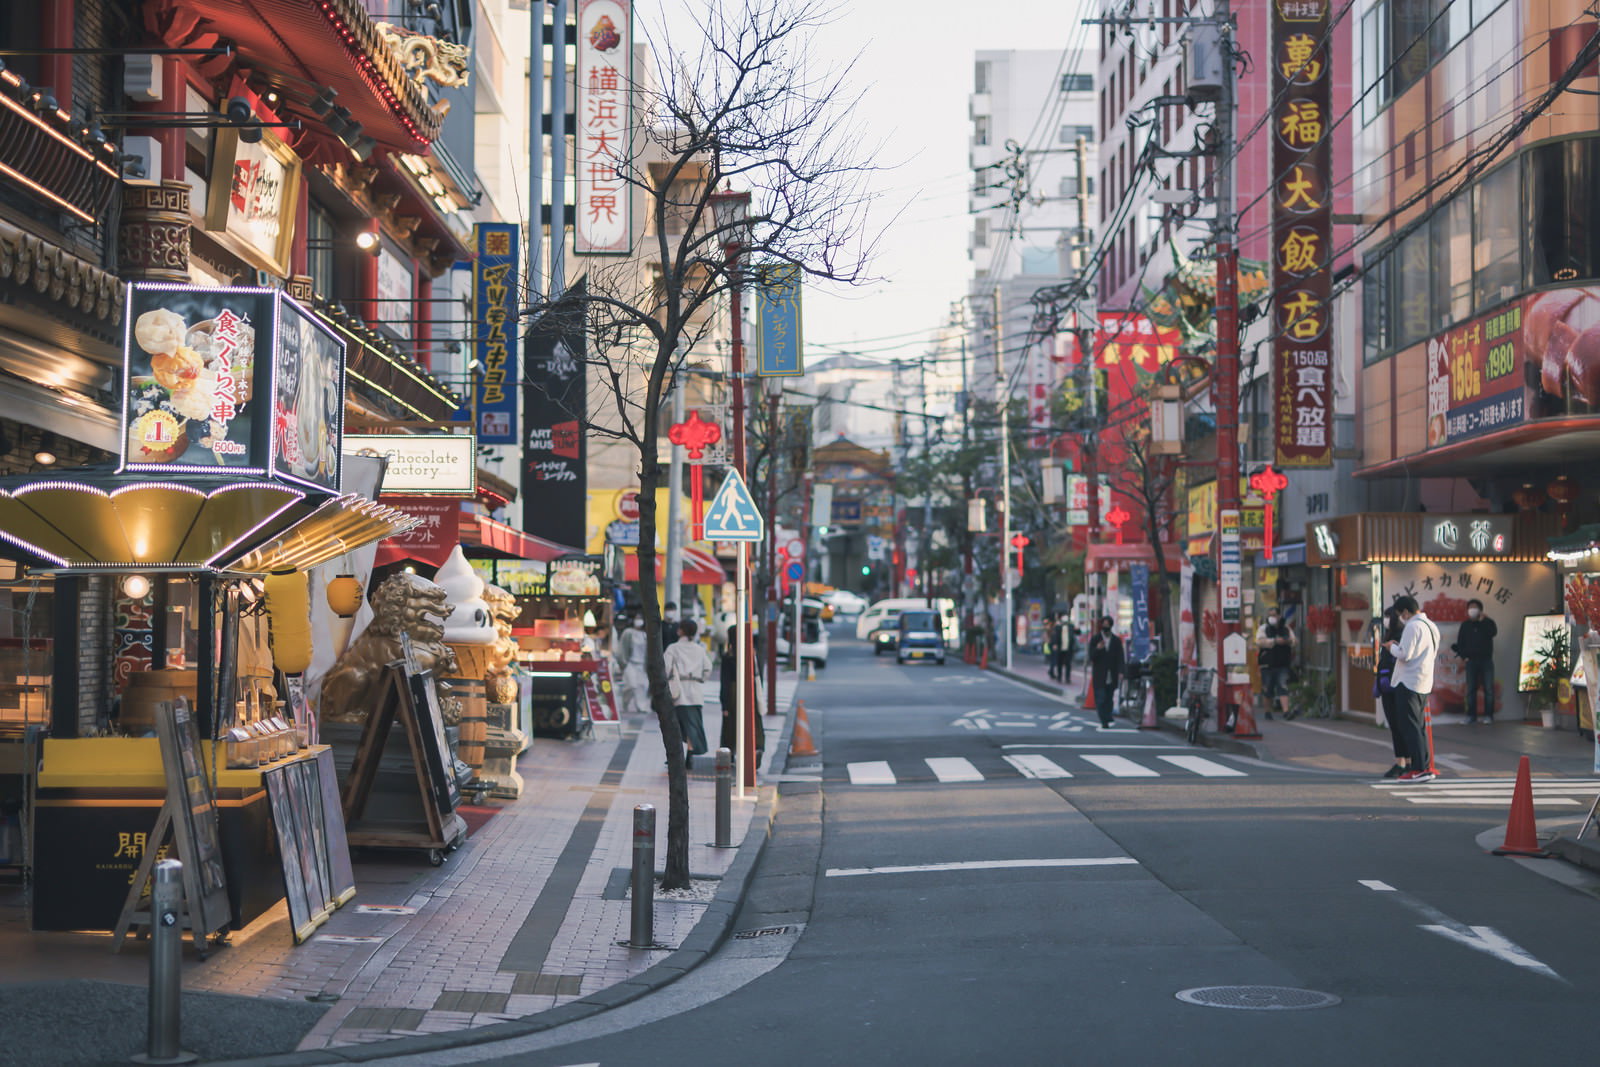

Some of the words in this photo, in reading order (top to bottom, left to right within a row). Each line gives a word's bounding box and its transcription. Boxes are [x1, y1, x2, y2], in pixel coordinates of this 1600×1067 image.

[1283, 1, 1320, 17] 料理
[587, 66, 619, 224] 横浜大世界
[1282, 33, 1323, 338] 萬福大飯店
[212, 309, 241, 424] 食べくらべ串
[482, 263, 511, 404] マツモトキヨシ
[1293, 350, 1327, 366] 150品
[1296, 366, 1326, 446] 食べ放題
[385, 449, 459, 464] Chocolate
[1434, 519, 1491, 552] 心茶
